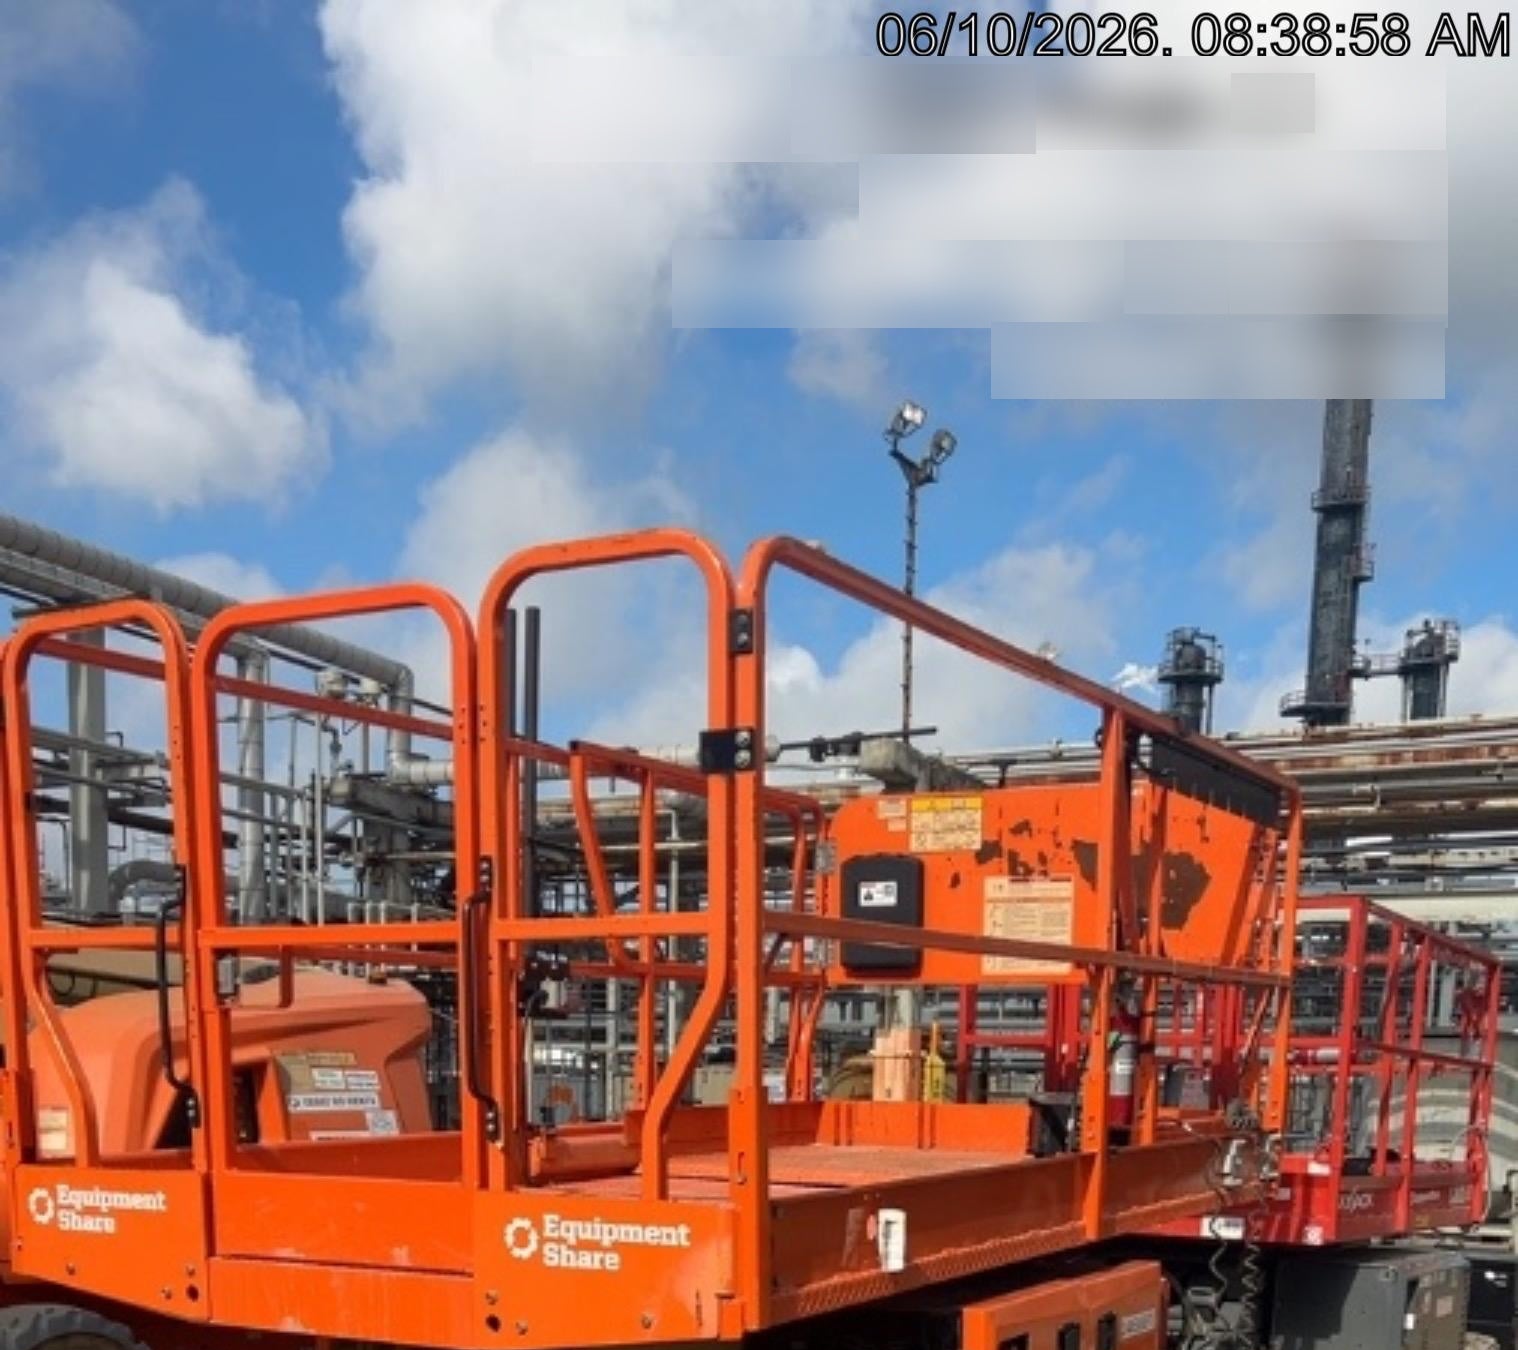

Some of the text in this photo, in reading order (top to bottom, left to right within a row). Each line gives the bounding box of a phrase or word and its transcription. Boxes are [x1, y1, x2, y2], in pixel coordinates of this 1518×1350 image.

[56, 1184, 167, 1213] Equipment
[57, 1210, 115, 1233] Share
[543, 1214, 691, 1247] Equipment
[543, 1242, 619, 1270] Share
